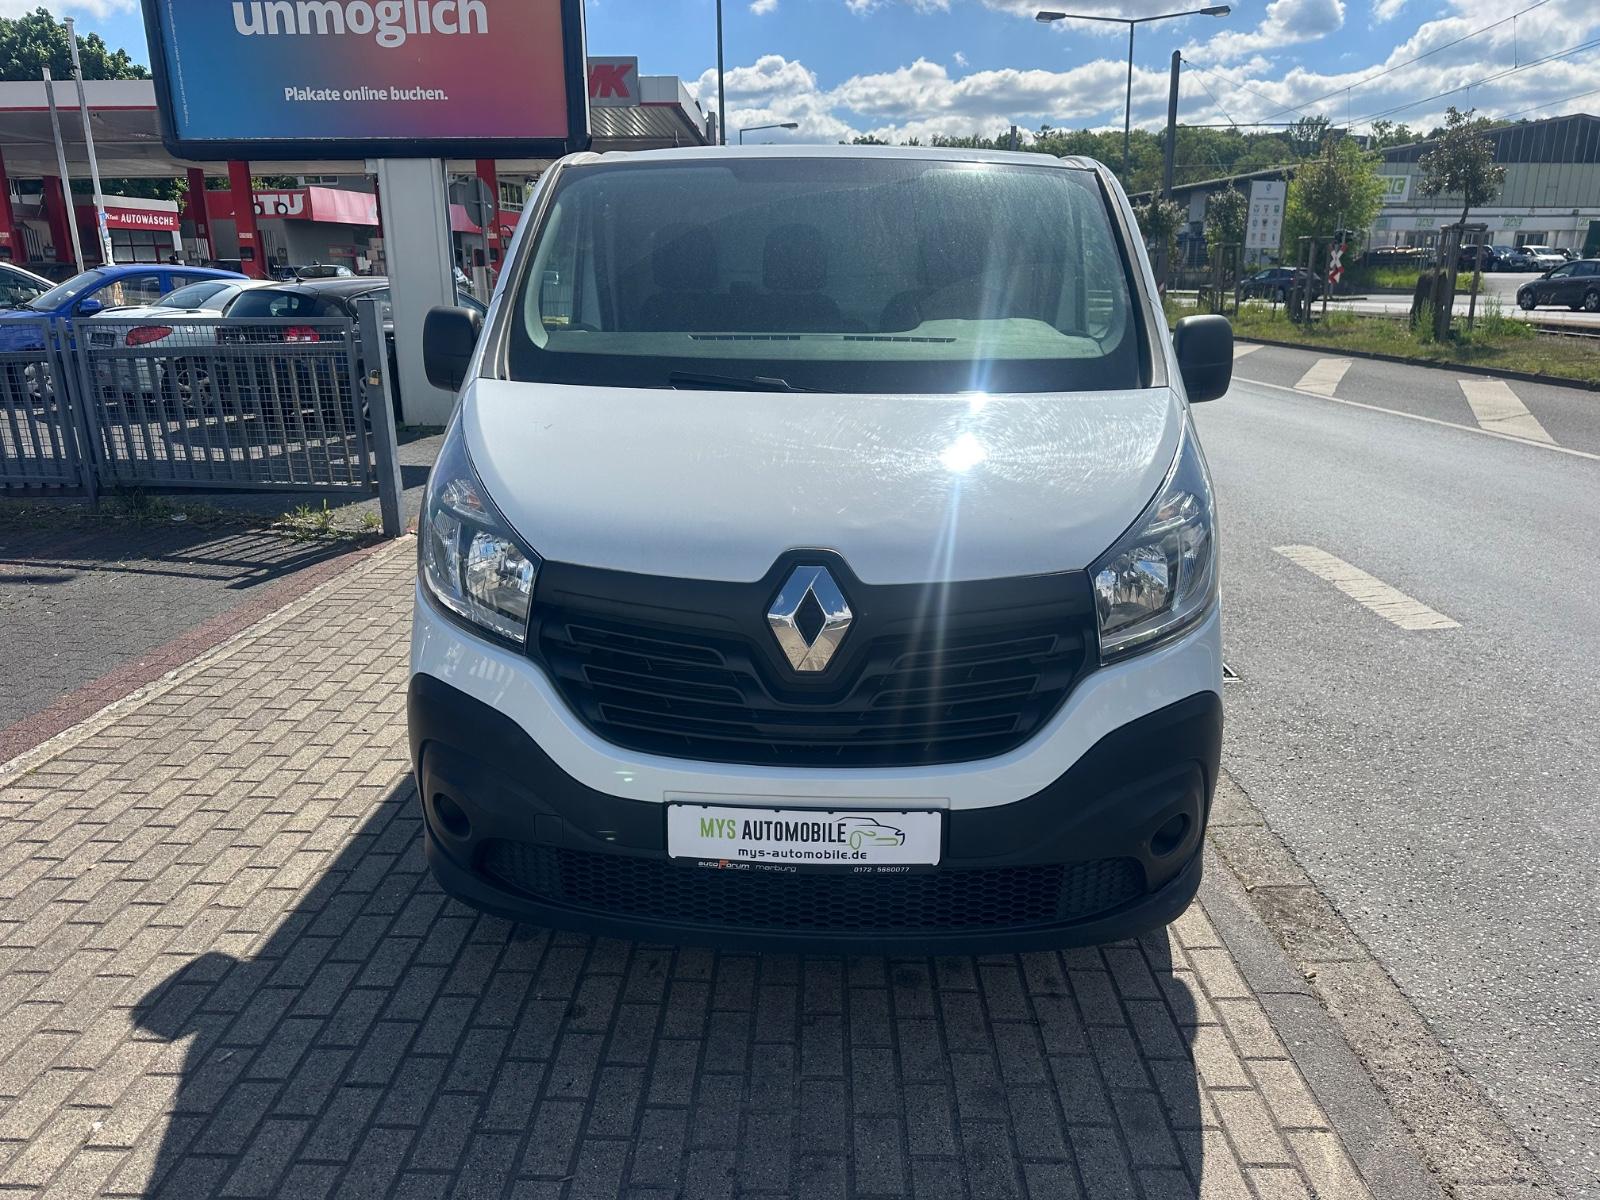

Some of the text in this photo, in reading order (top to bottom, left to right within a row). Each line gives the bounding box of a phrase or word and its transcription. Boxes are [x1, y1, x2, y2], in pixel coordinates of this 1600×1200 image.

[284, 86, 449, 101] Plakate online buchen.
[120, 213, 174, 226] AUTOWÄSCHE
[700, 817, 847, 843] MYS AUTOMOBILE
[738, 848, 867, 860] mys-automobile.de
